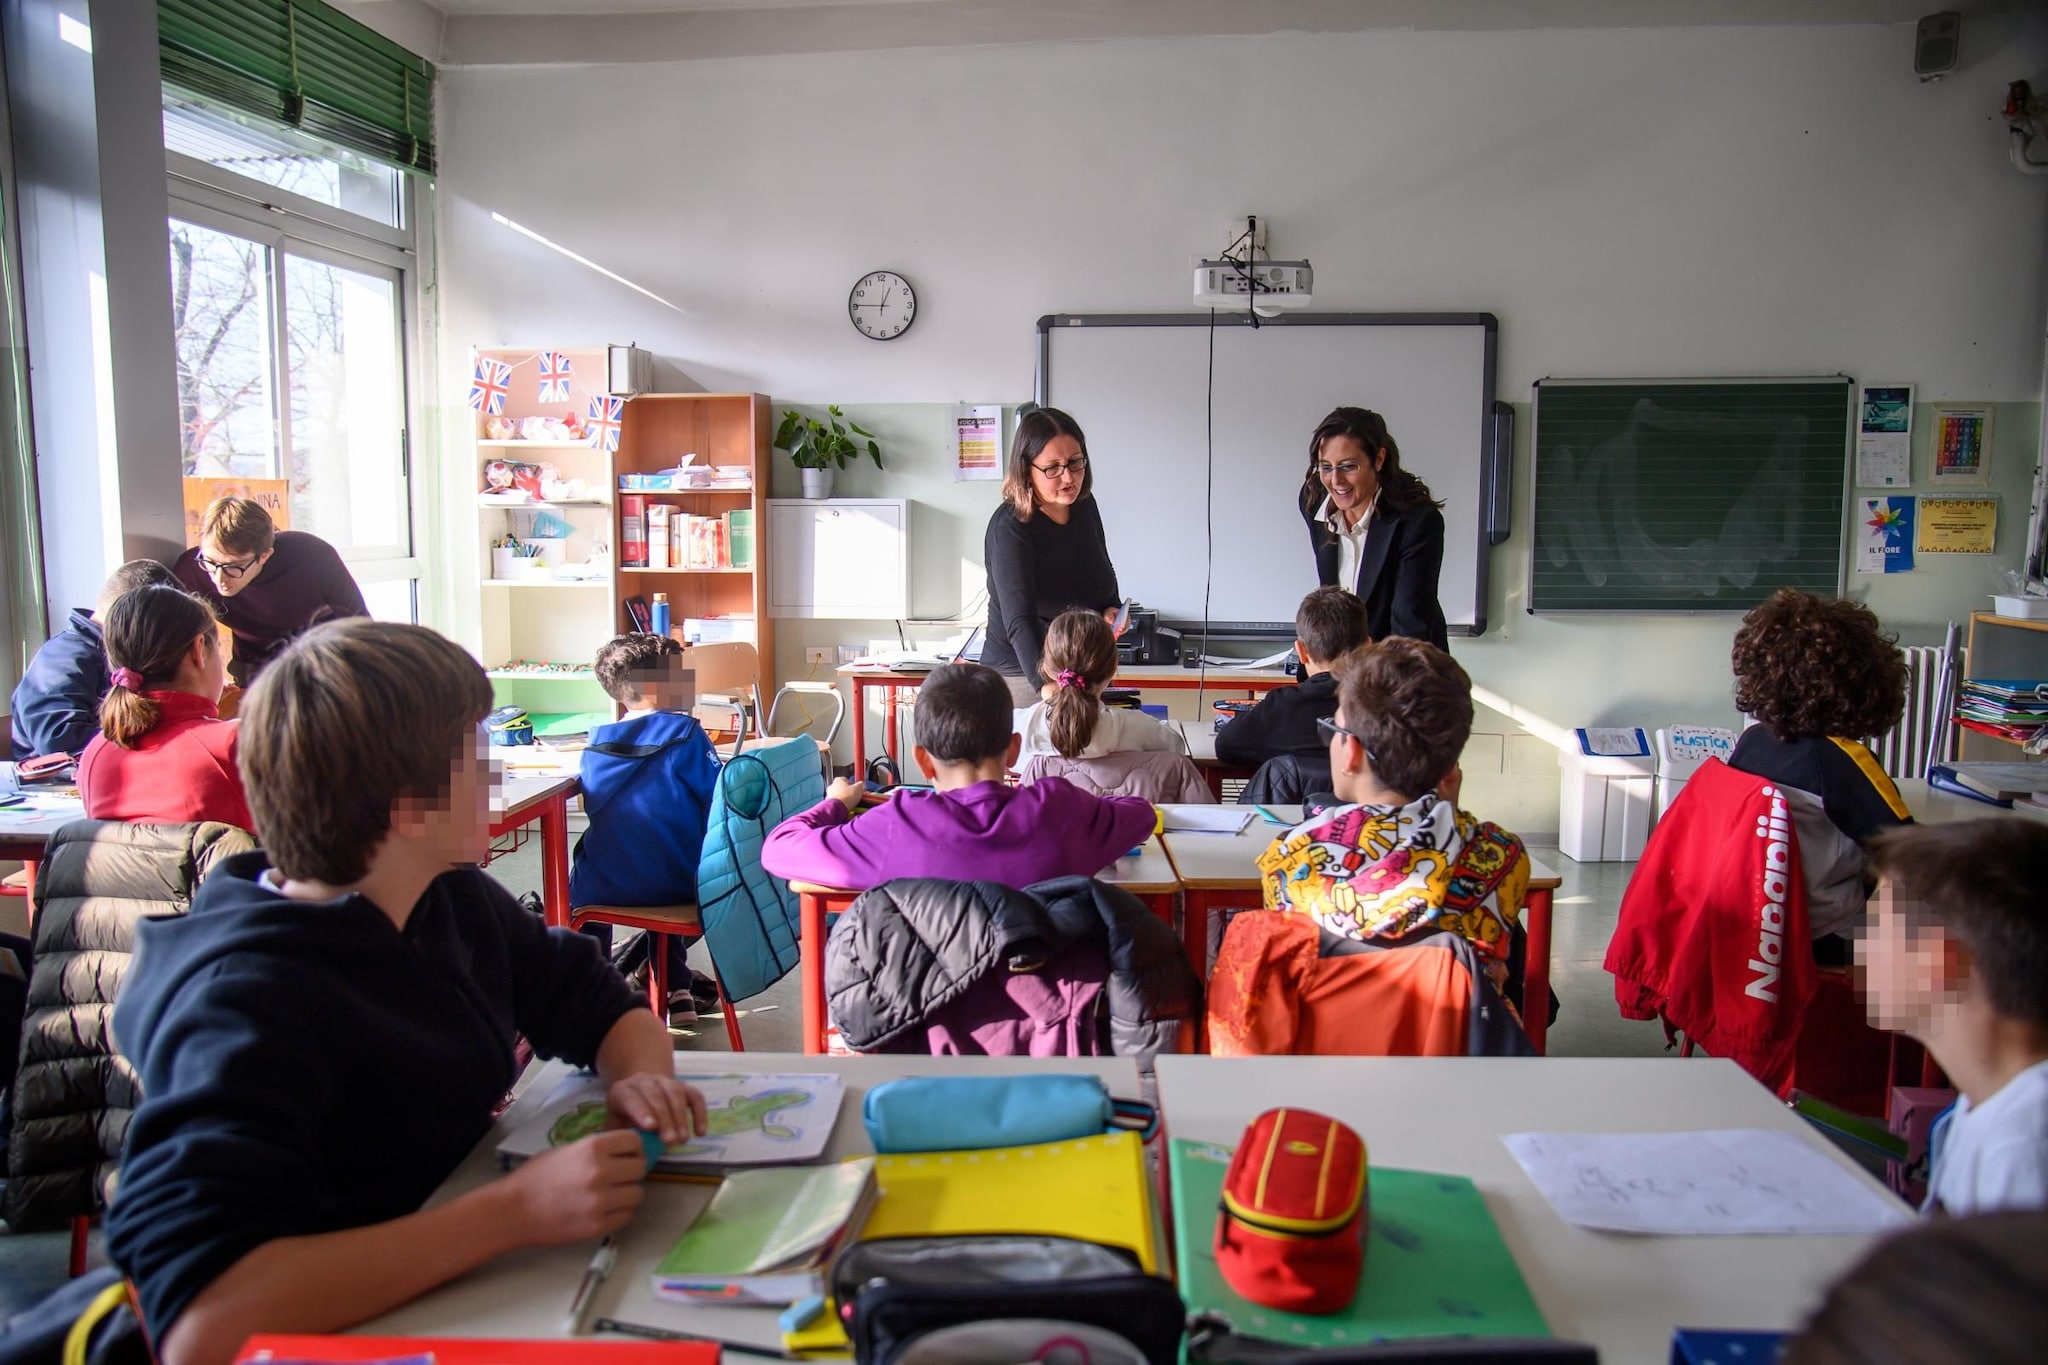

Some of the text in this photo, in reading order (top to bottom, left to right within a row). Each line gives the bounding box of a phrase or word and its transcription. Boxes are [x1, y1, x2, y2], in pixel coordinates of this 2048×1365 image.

[877, 274, 886, 282] 12
[852, 303, 859, 311] 9
[906, 301, 913, 309] 3
[866, 326, 873, 334] 7
[880, 329, 886, 337] 6
[893, 325, 900, 333] 5
[1869, 546, 1901, 554] IL FIORE
[1673, 735, 1729, 749] PLASTICA
